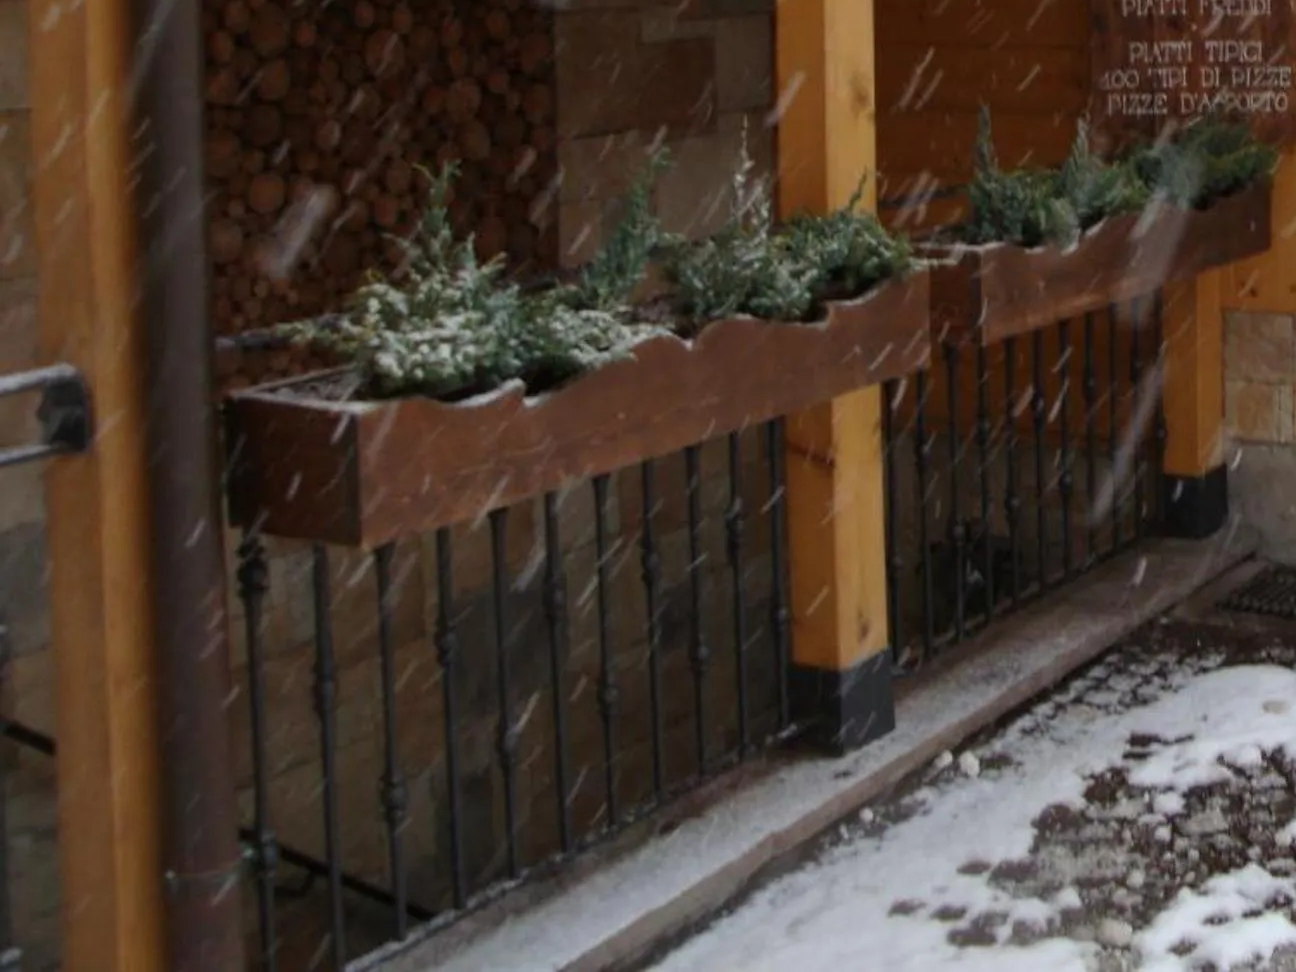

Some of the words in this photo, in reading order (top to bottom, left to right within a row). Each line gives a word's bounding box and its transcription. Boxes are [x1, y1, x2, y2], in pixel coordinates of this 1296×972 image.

[1129, 41, 1193, 64] PIATTI
[1205, 40, 1263, 63] TIPICI
[1148, 66, 1188, 88] TIPI
[1200, 67, 1220, 88] DI
[1231, 65, 1292, 88] PIZZE
[1107, 92, 1168, 116] PIZZE
